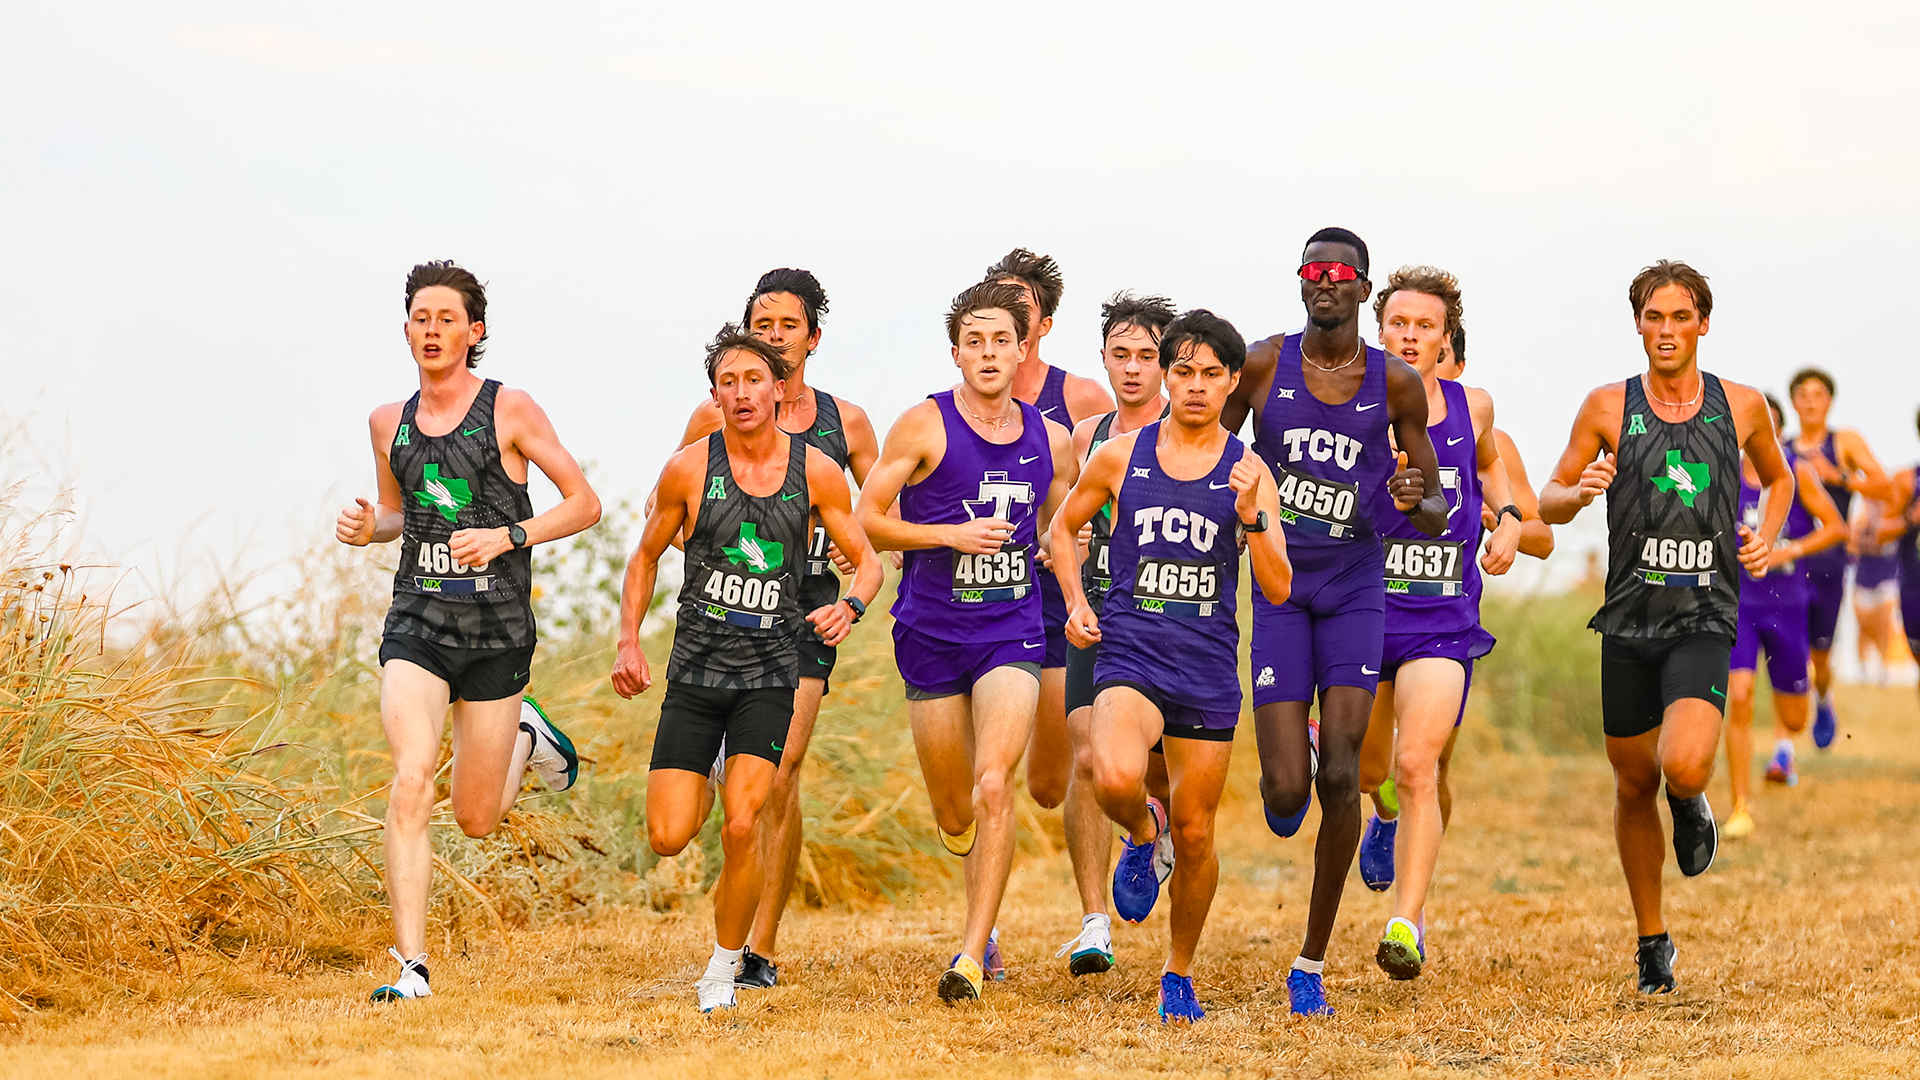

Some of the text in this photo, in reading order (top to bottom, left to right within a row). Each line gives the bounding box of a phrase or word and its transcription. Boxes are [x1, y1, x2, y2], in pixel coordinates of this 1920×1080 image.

[1283, 428, 1363, 471] TCU
[1278, 474, 1355, 521] 4650
[1134, 506, 1219, 553] TCU
[418, 542, 490, 574] 46
[955, 550, 1026, 585] 4635
[1385, 544, 1458, 577] 4637
[1641, 537, 1714, 570] 4608
[704, 570, 782, 611] 4606
[1138, 562, 1216, 598] 4655
